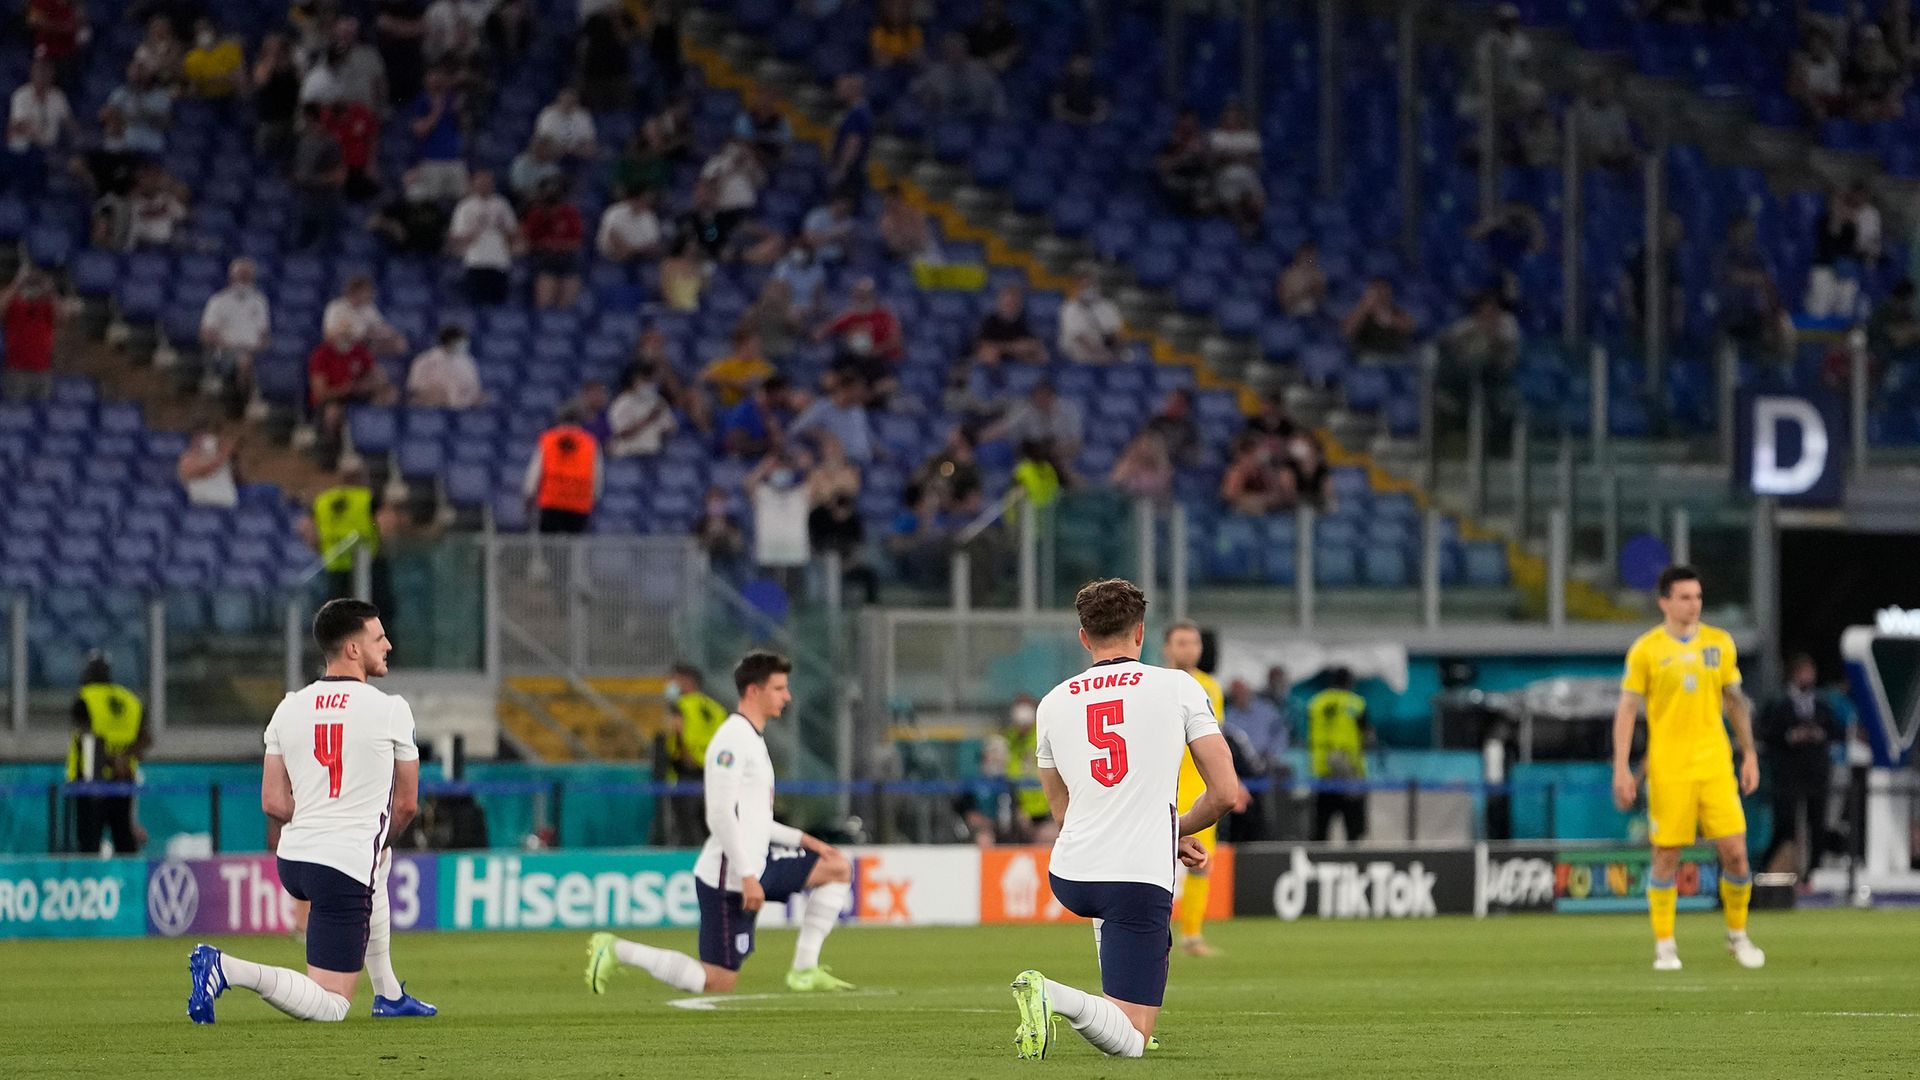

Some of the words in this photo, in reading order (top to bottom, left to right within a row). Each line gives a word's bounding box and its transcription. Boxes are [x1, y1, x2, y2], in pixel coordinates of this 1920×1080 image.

[1751, 397, 1828, 495] D
[1069, 672, 1143, 695] STONES
[1703, 647, 1720, 669] 10
[315, 693, 350, 710] RICE
[314, 723, 343, 798] 4
[1087, 699, 1128, 787] 5
[41, 877, 120, 921] 2020
[454, 856, 700, 928] Hisense
[1317, 861, 1437, 919] TikTok
